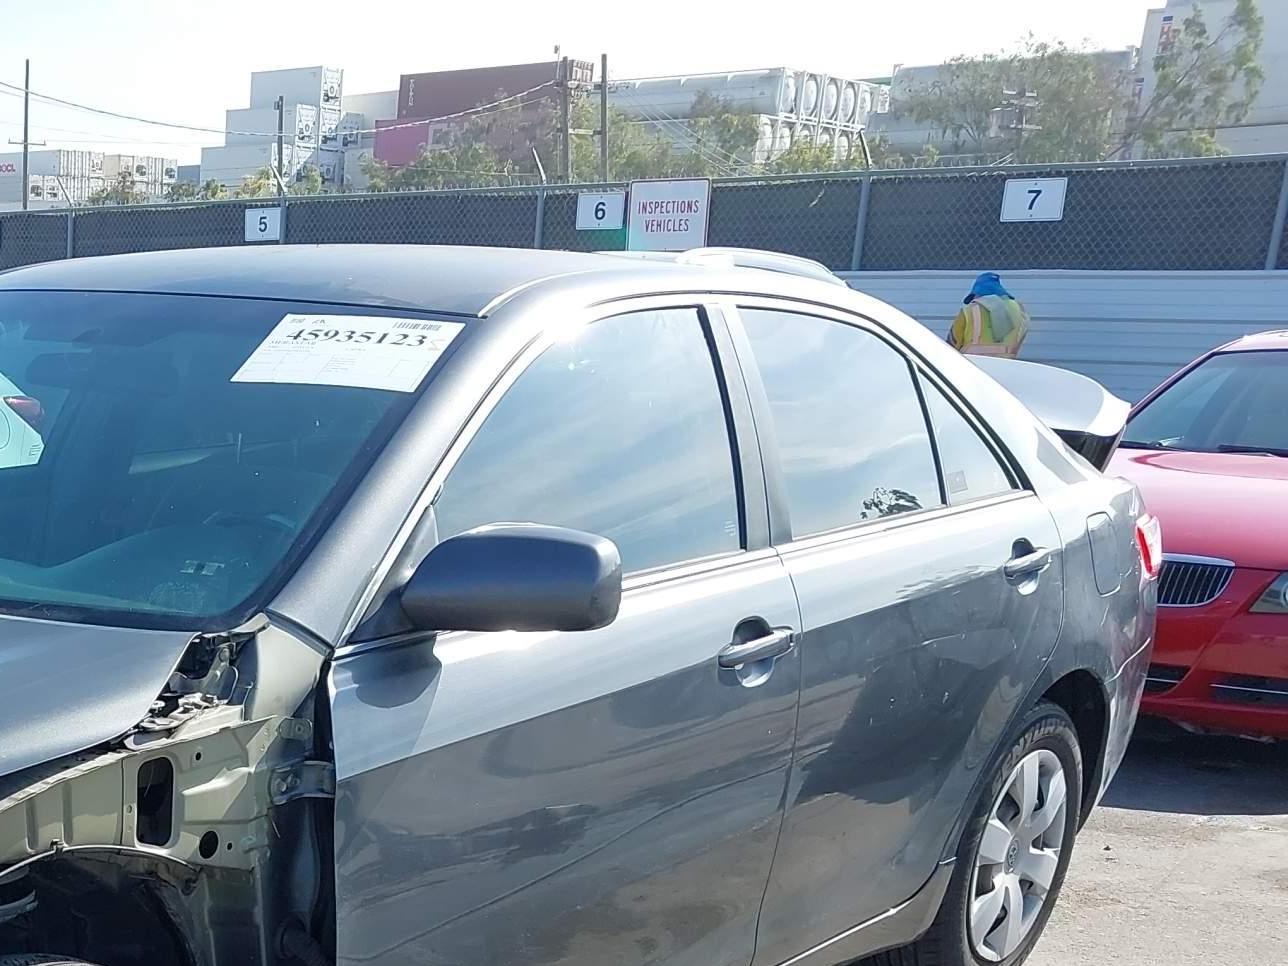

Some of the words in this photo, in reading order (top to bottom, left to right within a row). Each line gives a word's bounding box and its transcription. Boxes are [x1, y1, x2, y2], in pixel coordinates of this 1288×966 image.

[637, 200, 700, 215] INSPECTIONS
[1027, 189, 1043, 210] 7
[594, 201, 607, 220] 6
[258, 216, 268, 233] 5
[644, 219, 690, 233] VEHICLES
[286, 328, 428, 347] 45935123
